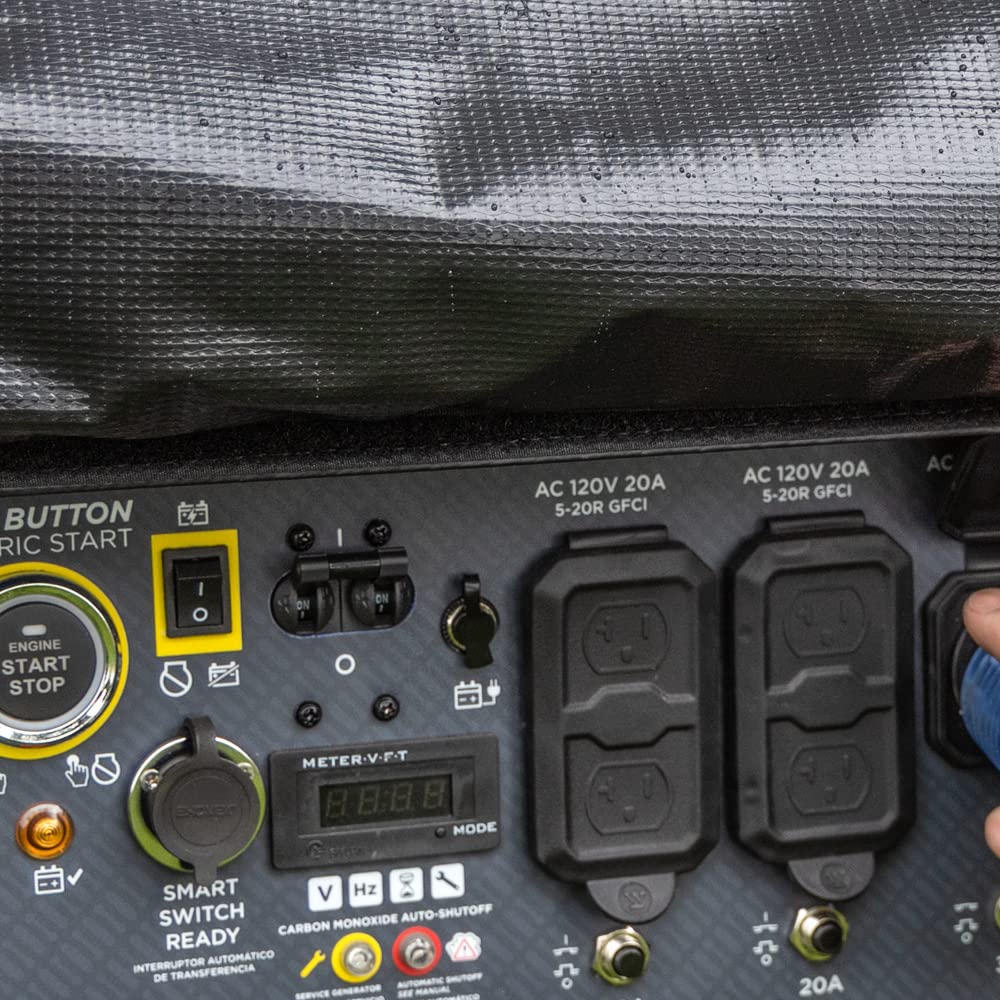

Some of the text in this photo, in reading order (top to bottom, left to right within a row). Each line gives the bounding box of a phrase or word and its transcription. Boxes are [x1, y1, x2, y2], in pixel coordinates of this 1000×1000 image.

[743, 460, 870, 484] AC 120V 20A
[926, 454, 954, 473] AC
[535, 474, 666, 498] AC 120V 20A
[762, 484, 852, 503] 5-20R GFCI
[4, 500, 133, 531] BUTTON
[554, 498, 648, 517] 5-20R GFCI
[0, 528, 133, 557] RIC START
[296, 600, 310, 611] ON
[376, 593, 389, 604] ON
[9, 639, 62, 653] ENGINE
[2, 655, 71, 674] START
[9, 676, 66, 696] STOP
[453, 822, 497, 836] MODE
[163, 878, 239, 901] SMART
[318, 885, 333, 902] V
[354, 882, 377, 897] Hz
[159, 902, 245, 927] SWITCH
[278, 903, 493, 936] CARBON MONOXIDE AUTO-SHUTOFF
[166, 927, 241, 951] READY
[133, 957, 205, 974] INTERRUPTOR
[153, 963, 256, 983] DE TRANSFERENCIA
[397, 972, 483, 989] AUTOMATIC SHUTOFF
[799, 974, 844, 996] 20A
[295, 984, 382, 1000] SERVICE GENERATOR
